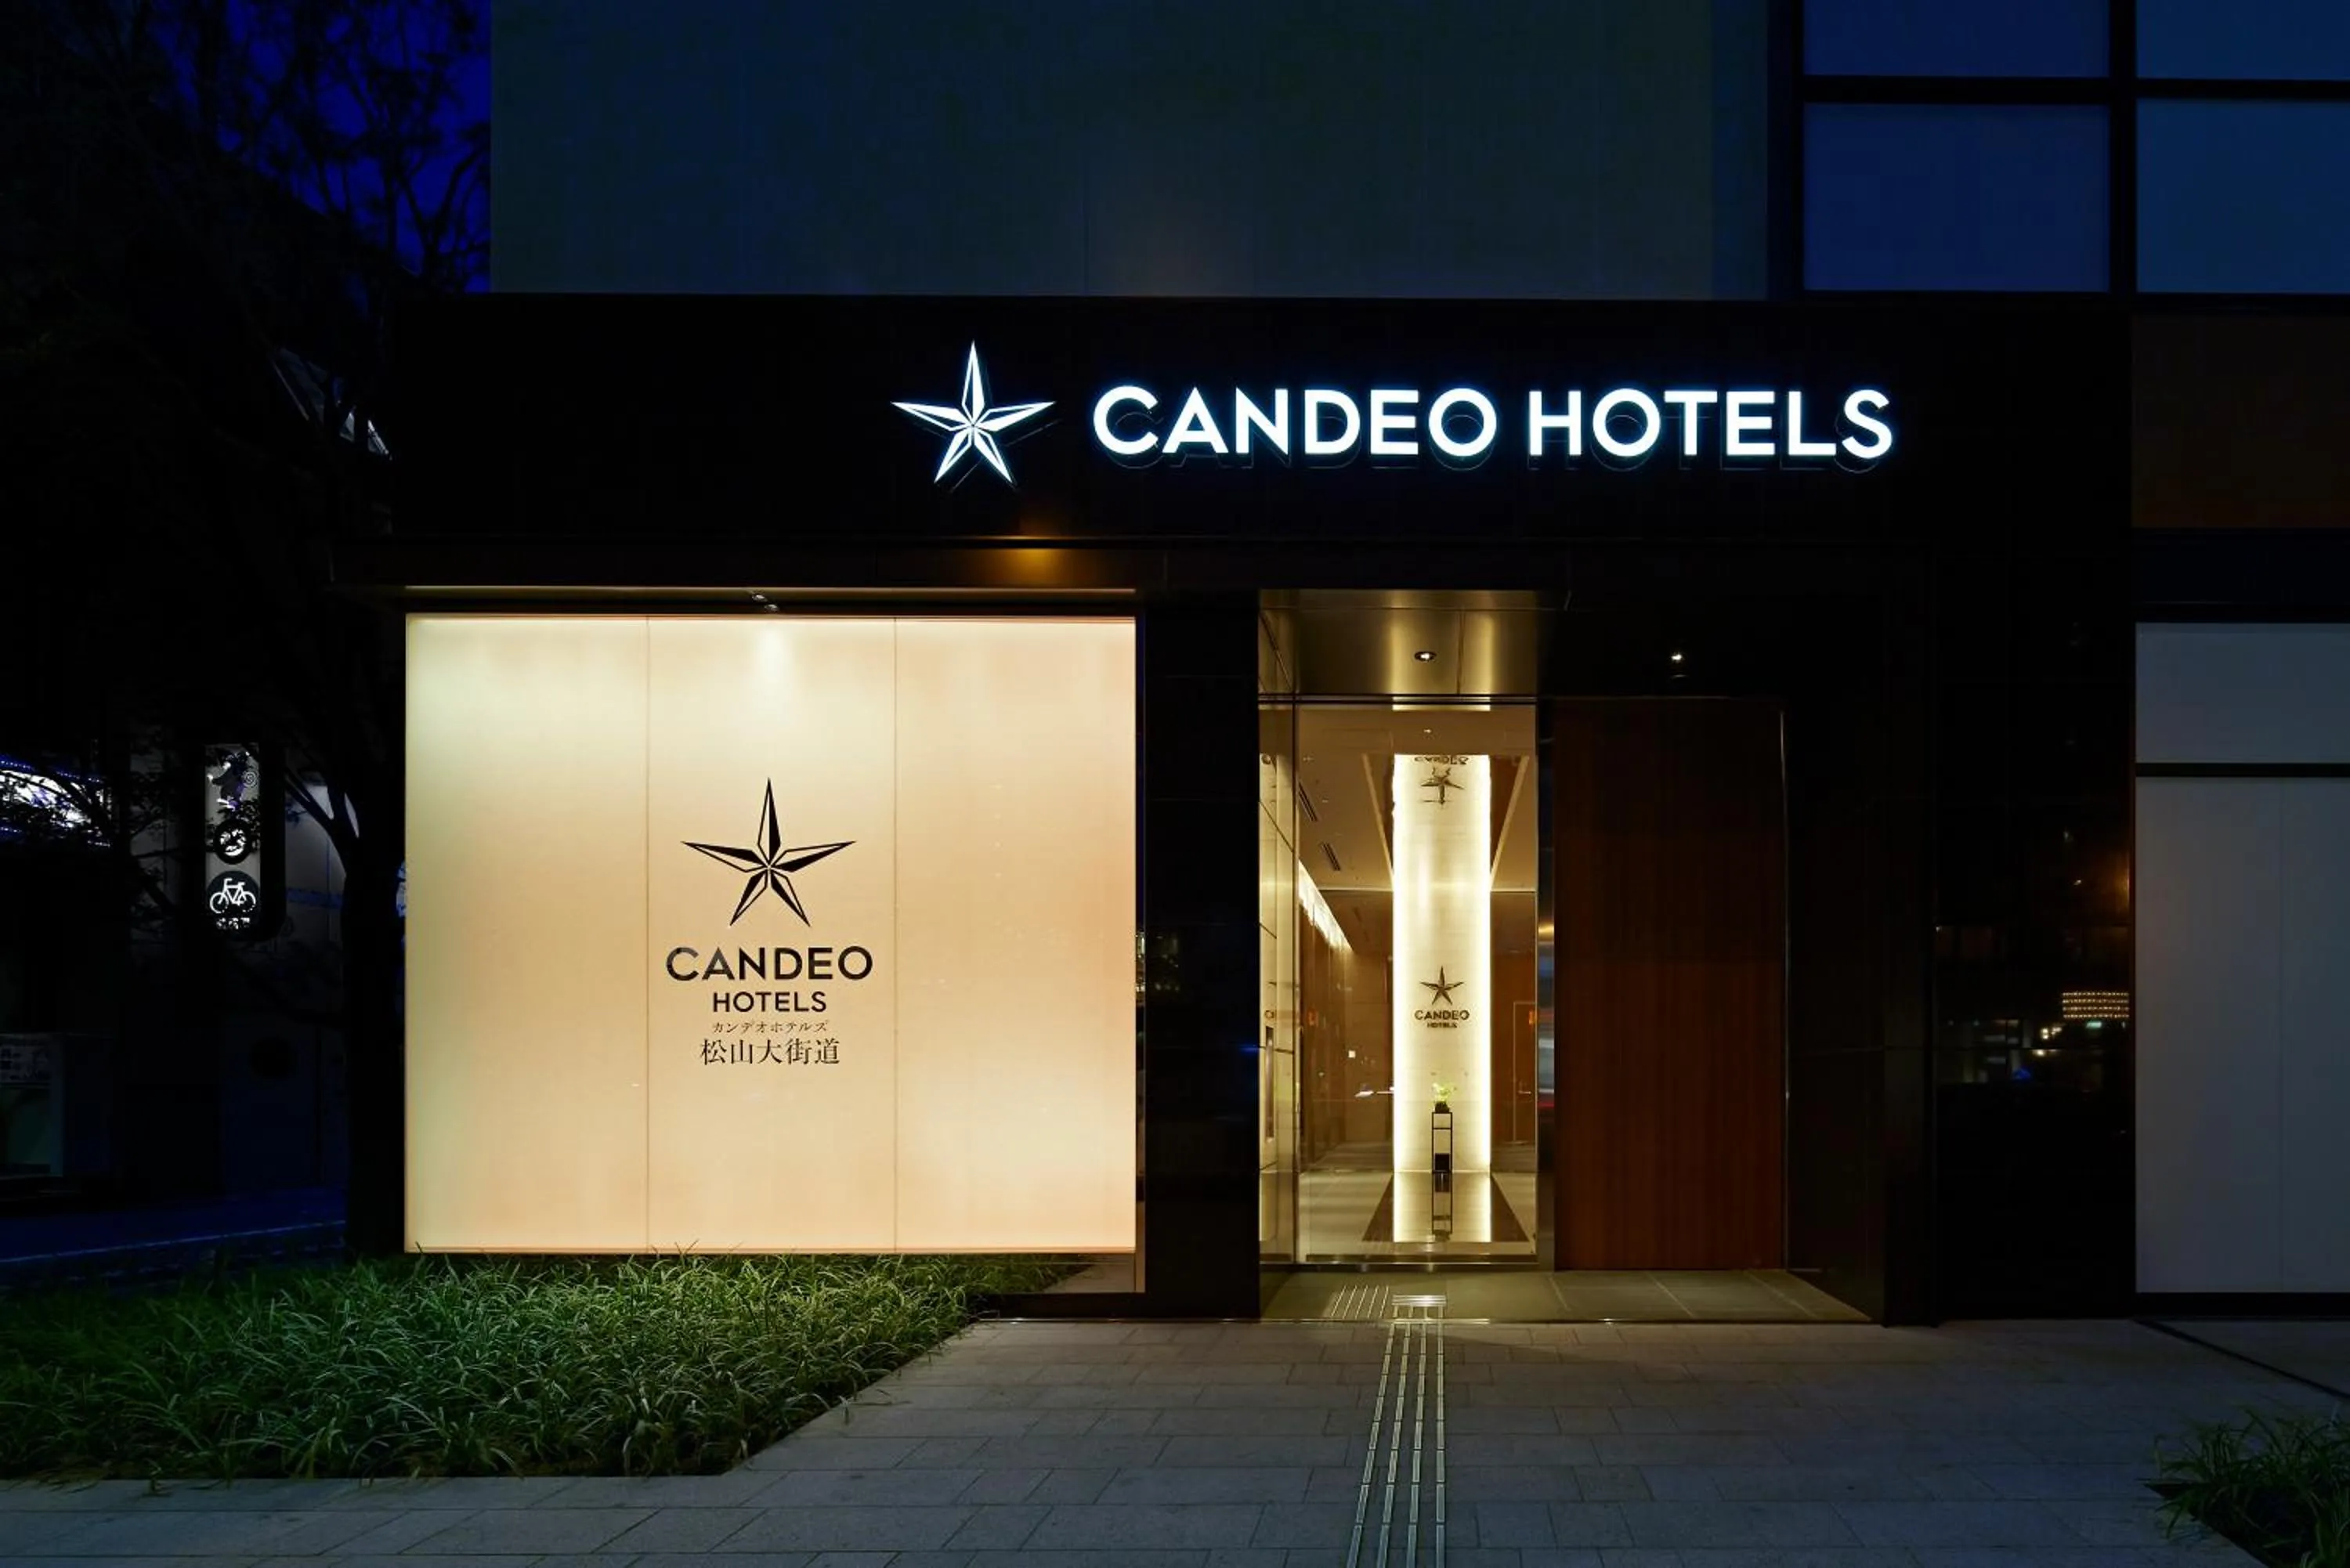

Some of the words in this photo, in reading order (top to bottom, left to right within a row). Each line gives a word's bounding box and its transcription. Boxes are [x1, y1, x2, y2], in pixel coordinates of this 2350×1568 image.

[1093, 385, 1497, 457] CANDEO
[1528, 388, 1893, 460] HOTELS
[666, 945, 873, 981] CANDEO
[713, 991, 827, 1013] HOTELS
[713, 1020, 829, 1034] カンデオホテルズ
[1414, 1010, 1470, 1021] CANDEO
[700, 1038, 841, 1066] 松山大街道
